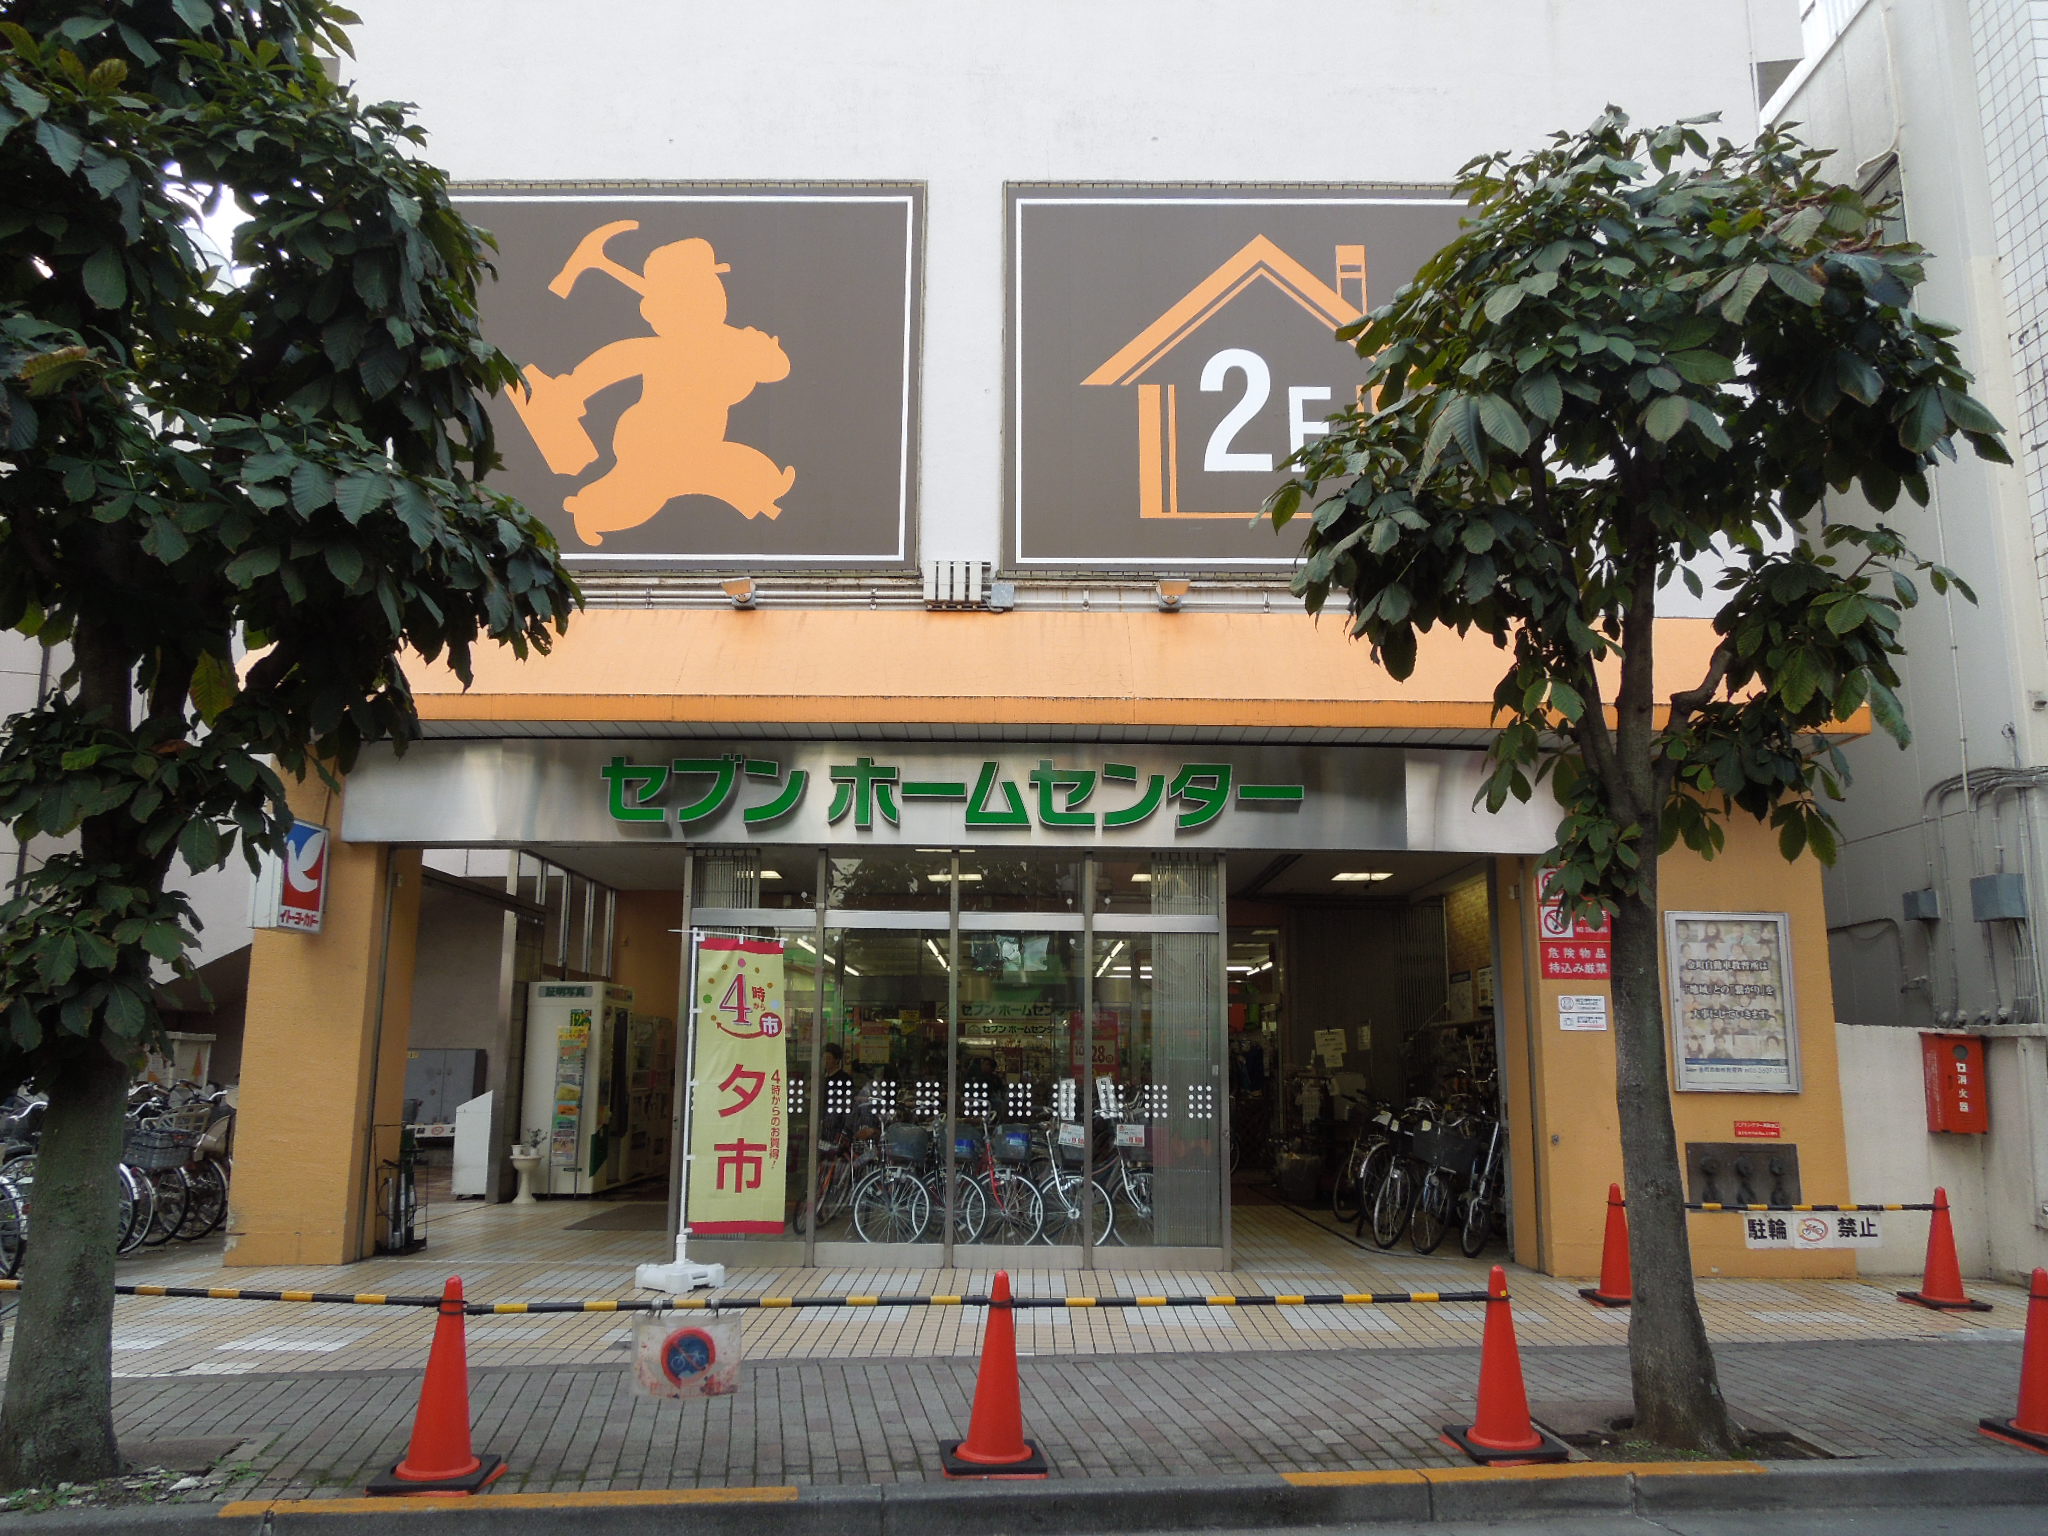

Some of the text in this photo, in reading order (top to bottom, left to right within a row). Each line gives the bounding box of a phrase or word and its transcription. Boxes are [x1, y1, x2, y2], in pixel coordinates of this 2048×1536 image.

[1200, 348, 1331, 473] 2F
[601, 754, 1304, 829] セブン ホームセンター
[1548, 947, 1607, 959] 危険物品
[1548, 962, 1608, 974] 持込み厳禁
[1747, 1217, 1878, 1240] 駐輪 禁止
